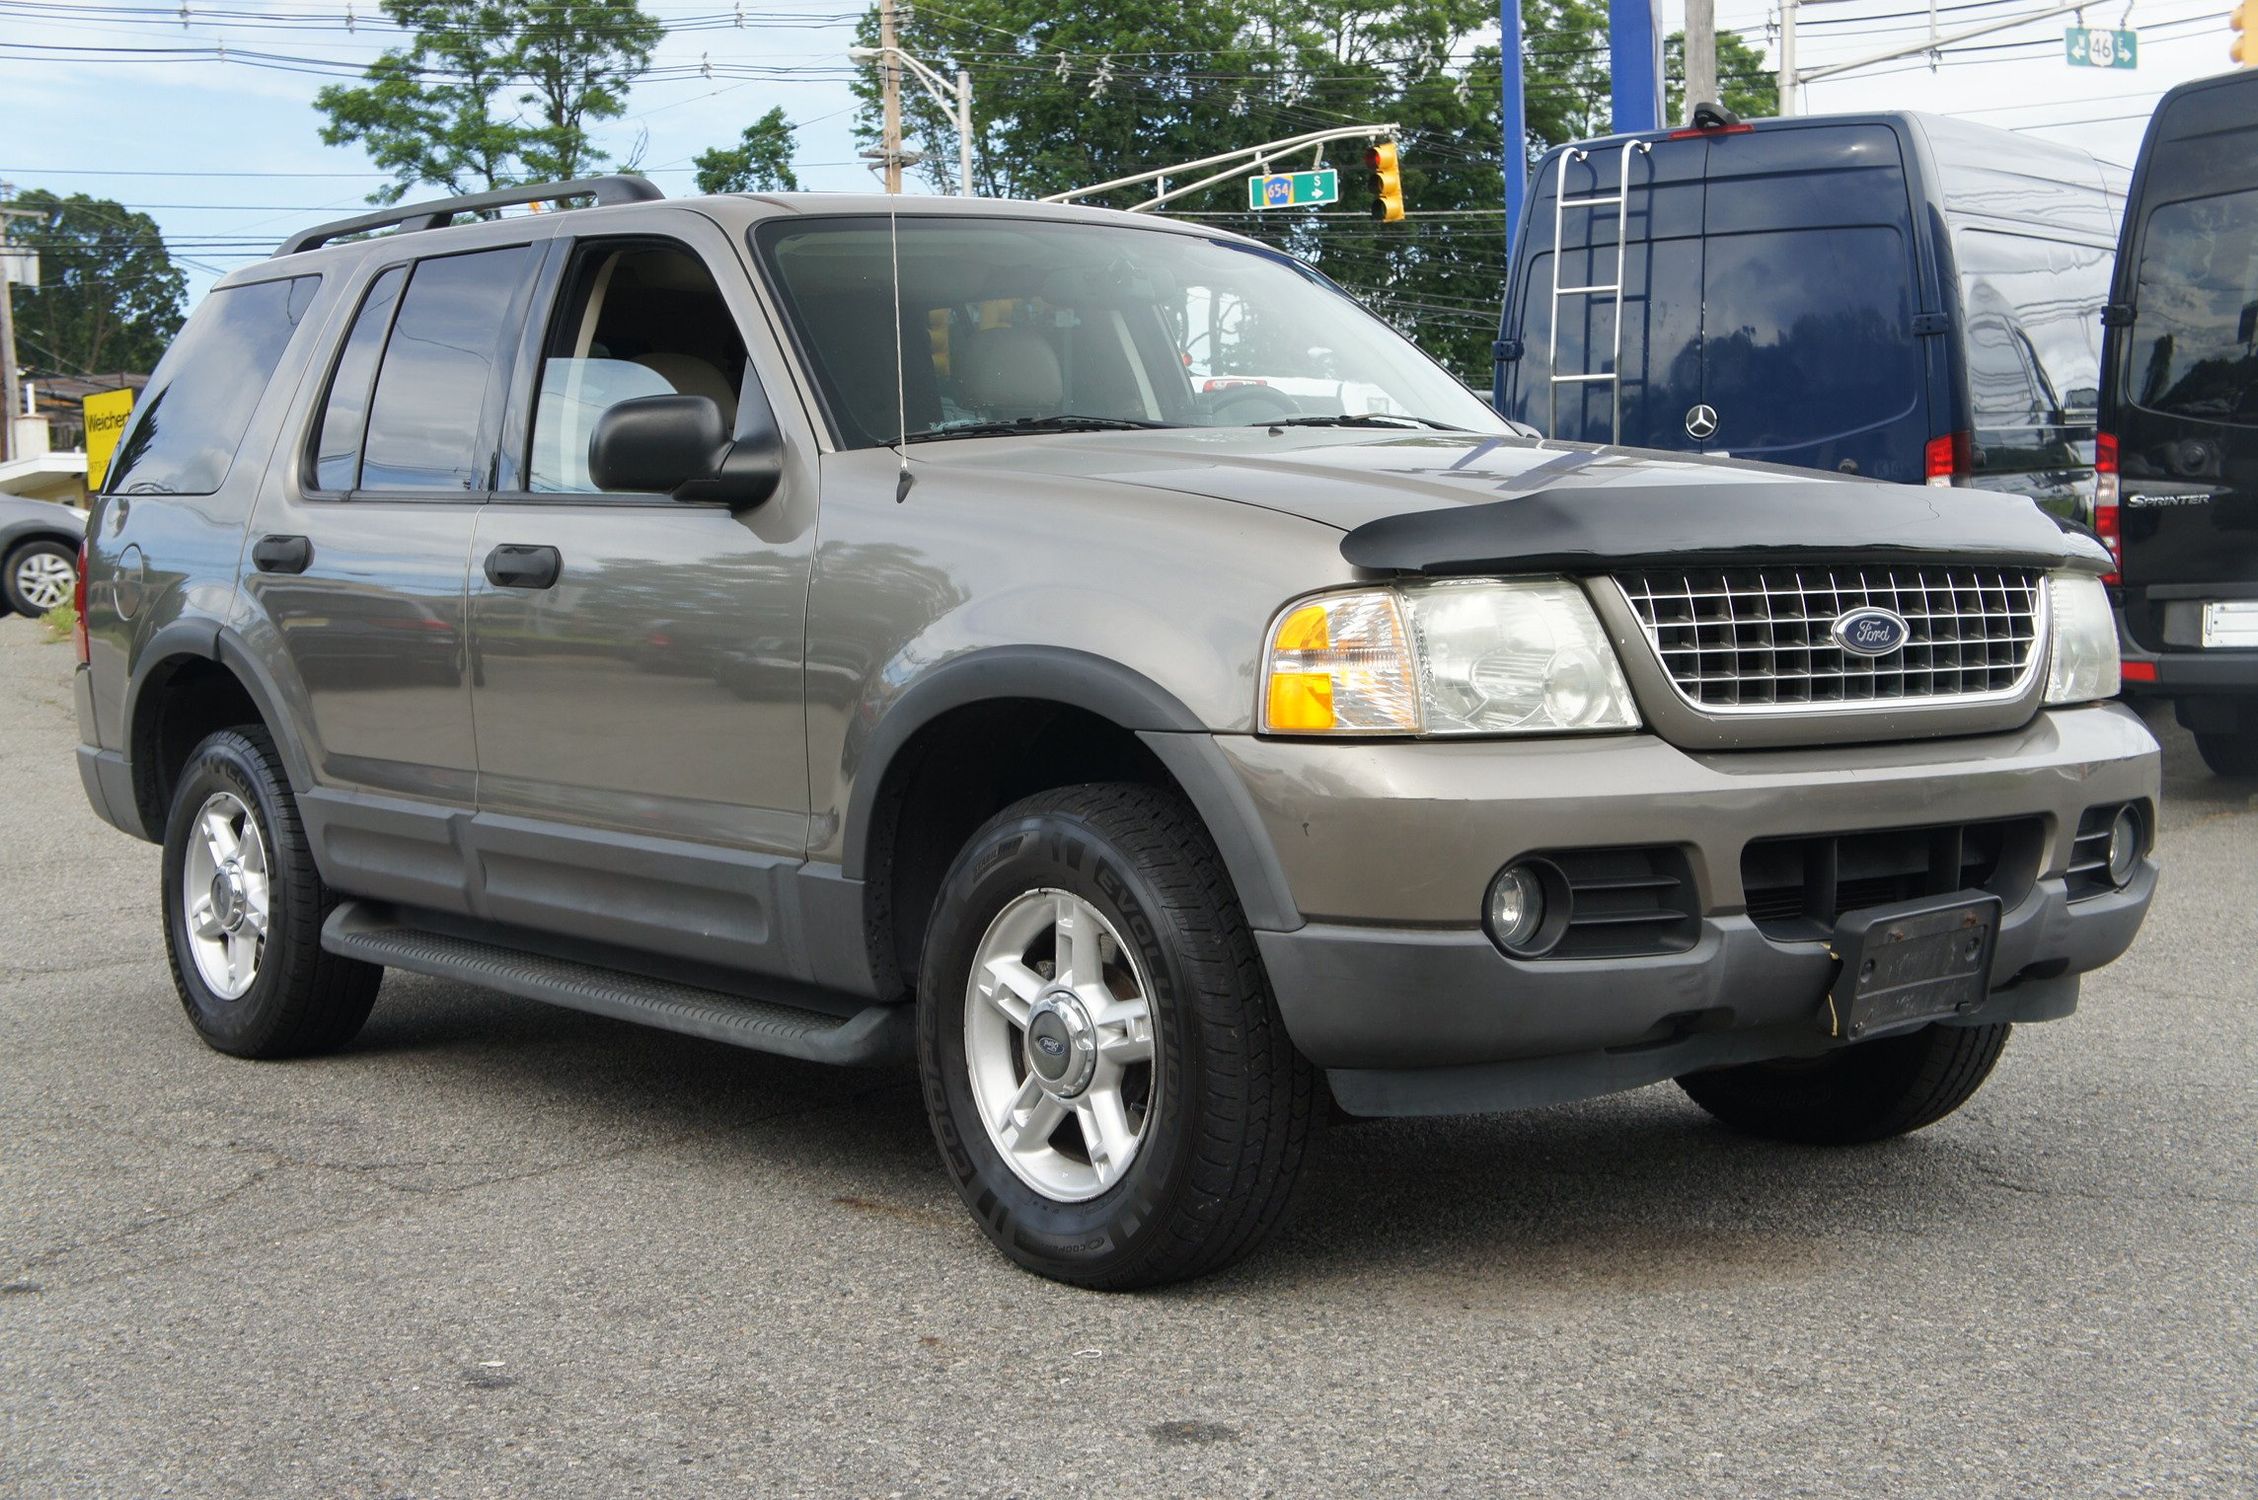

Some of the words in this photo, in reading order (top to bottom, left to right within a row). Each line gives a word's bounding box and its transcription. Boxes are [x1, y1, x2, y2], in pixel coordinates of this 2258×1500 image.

[2092, 38, 2111, 58] 46
[1313, 175, 1321, 187] S
[1268, 184, 1289, 198] 654
[2128, 495, 2210, 508] SPRINTER
[1856, 620, 1890, 642] Ford
